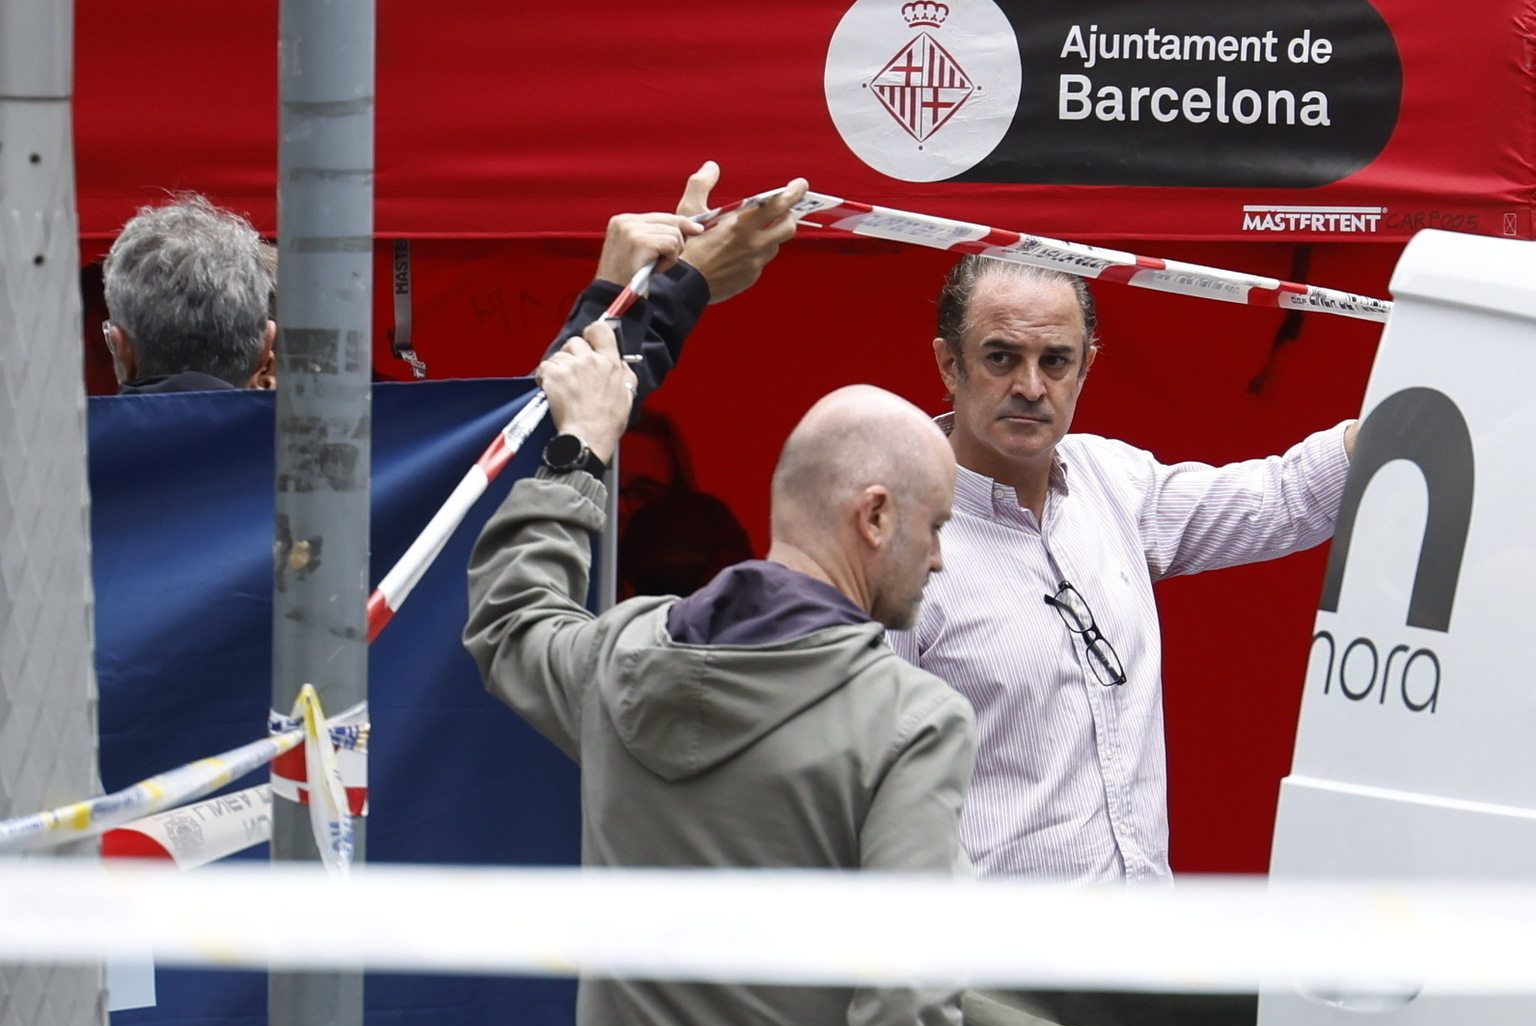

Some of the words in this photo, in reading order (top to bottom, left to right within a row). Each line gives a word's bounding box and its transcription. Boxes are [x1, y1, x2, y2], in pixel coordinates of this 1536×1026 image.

[1060, 24, 1278, 68] Ajuntament
[1288, 29, 1333, 64] de
[1058, 73, 1331, 127] Barcelona
